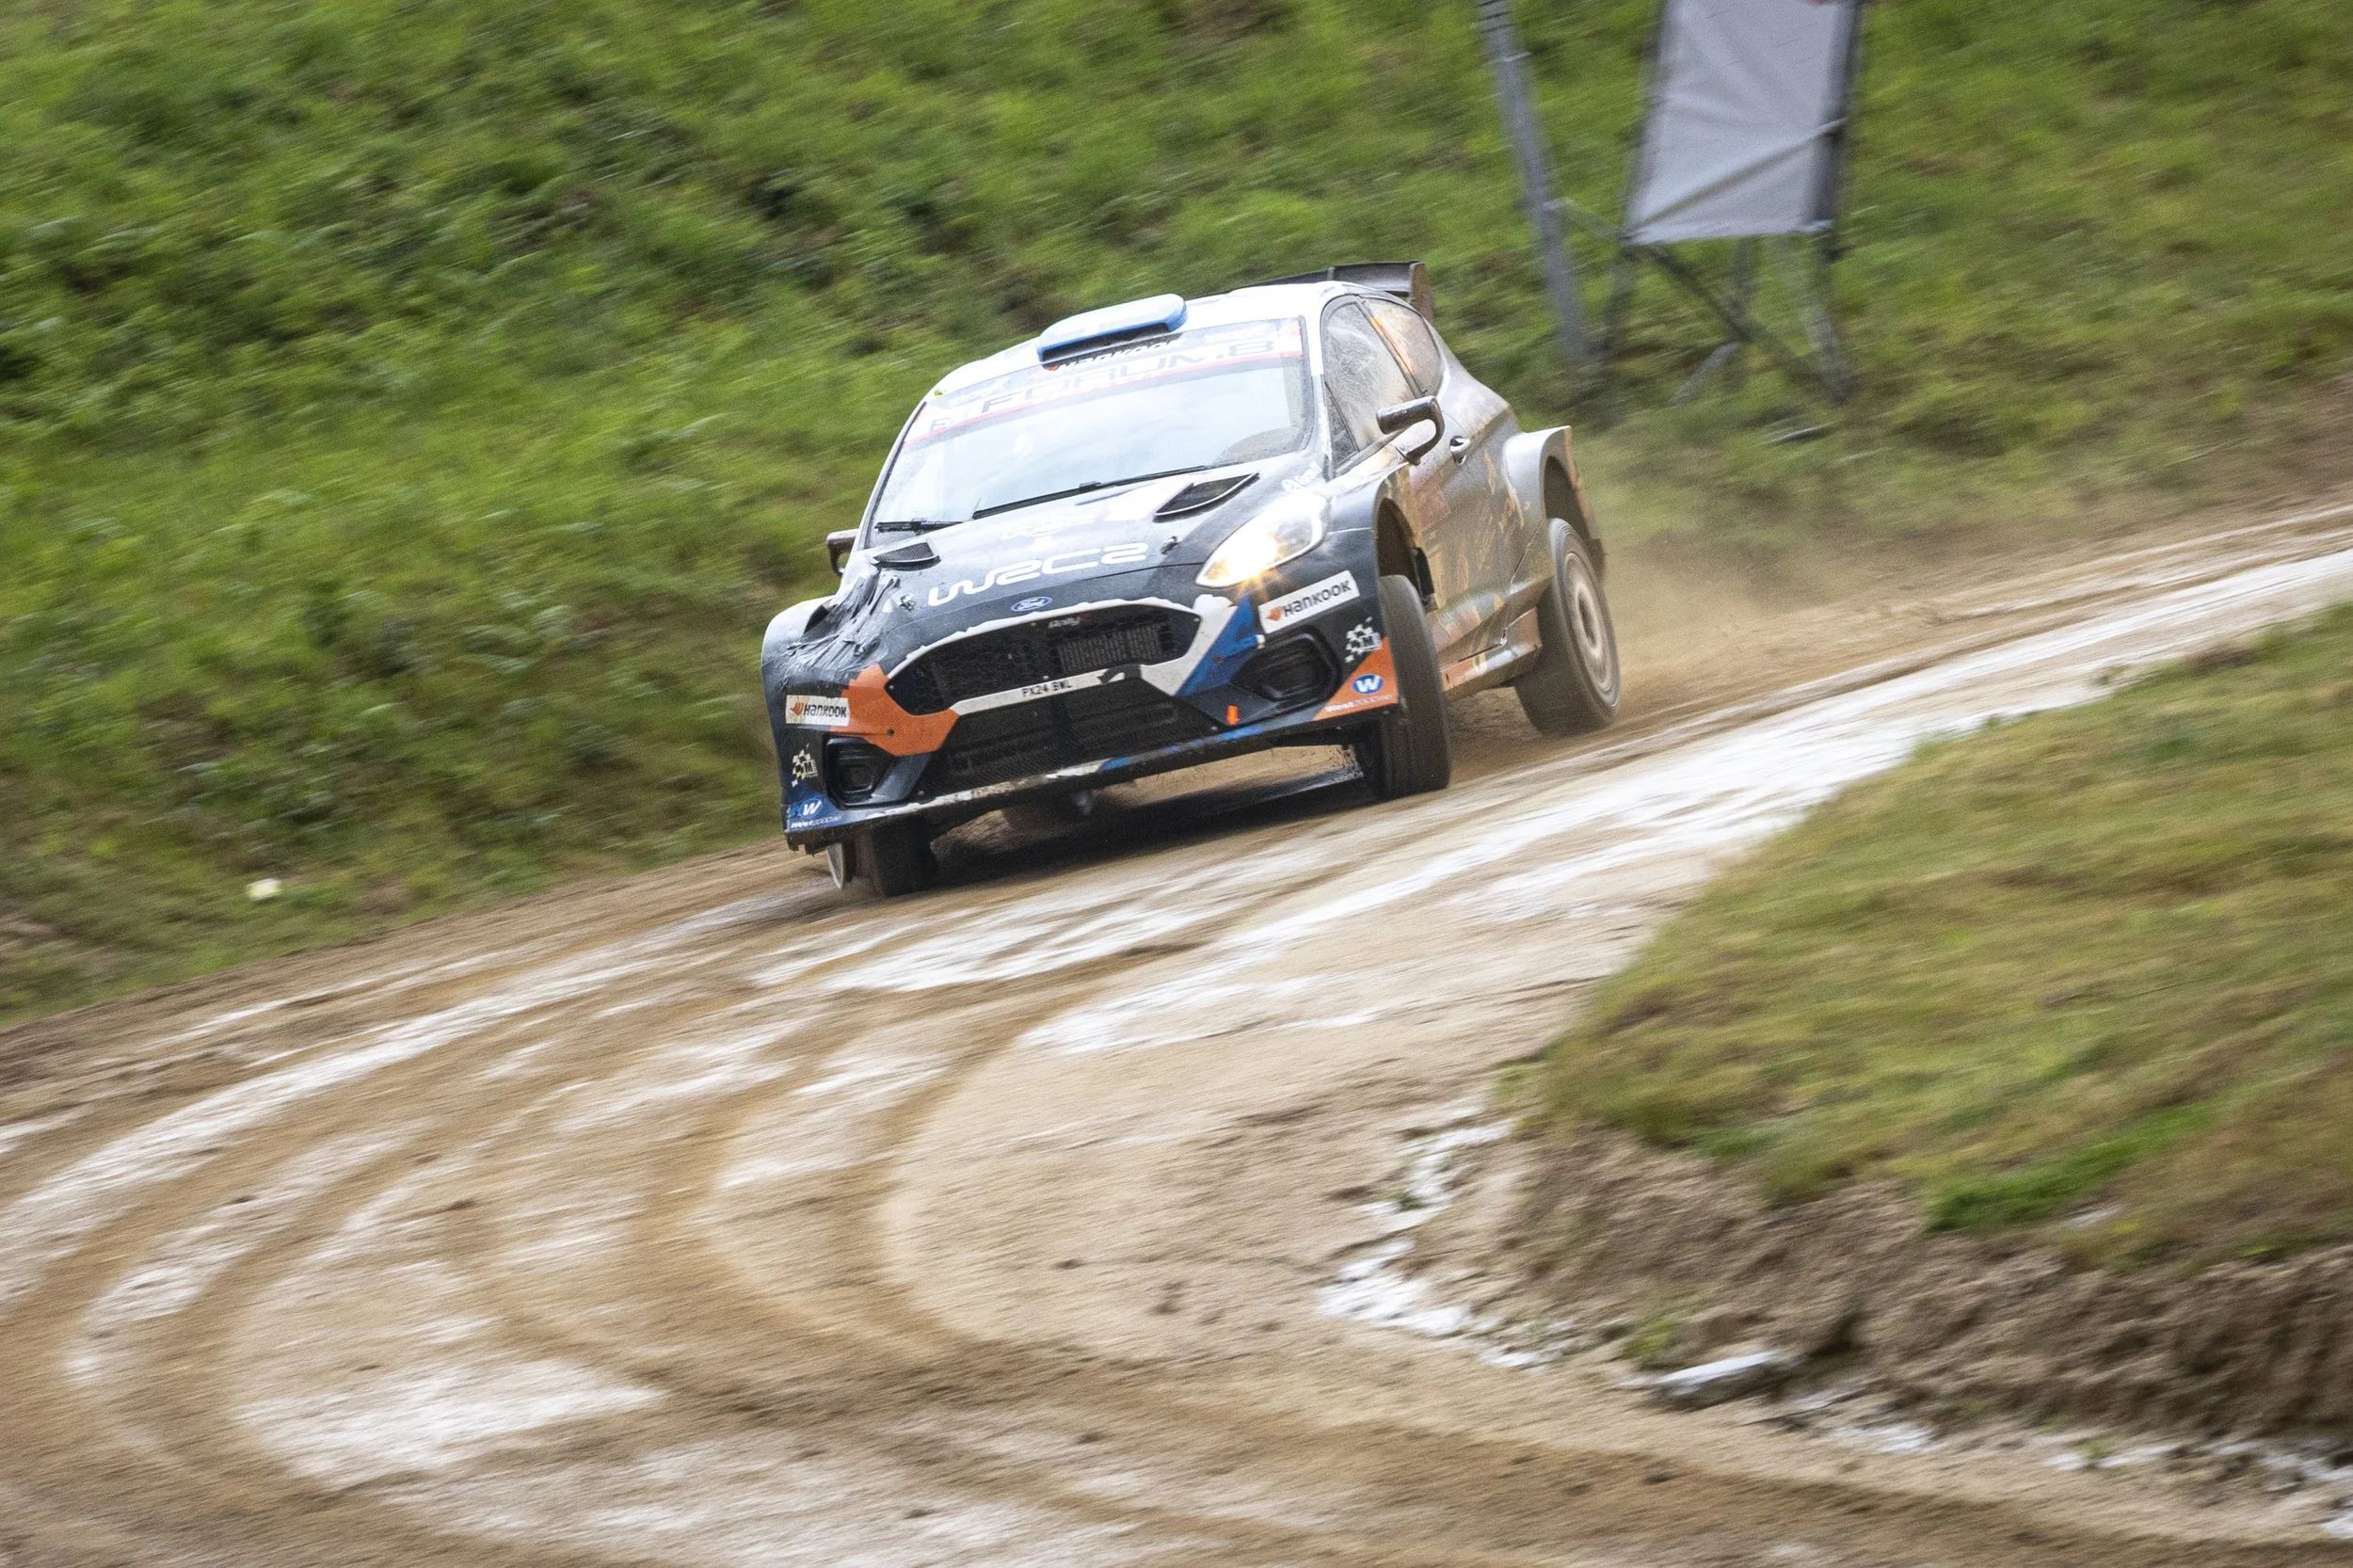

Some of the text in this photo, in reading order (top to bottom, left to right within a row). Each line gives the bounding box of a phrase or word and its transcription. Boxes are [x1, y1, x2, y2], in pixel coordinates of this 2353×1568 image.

[928, 542, 1148, 606] WRC2
[1355, 675, 1380, 693] W
[803, 800, 822, 816] W
